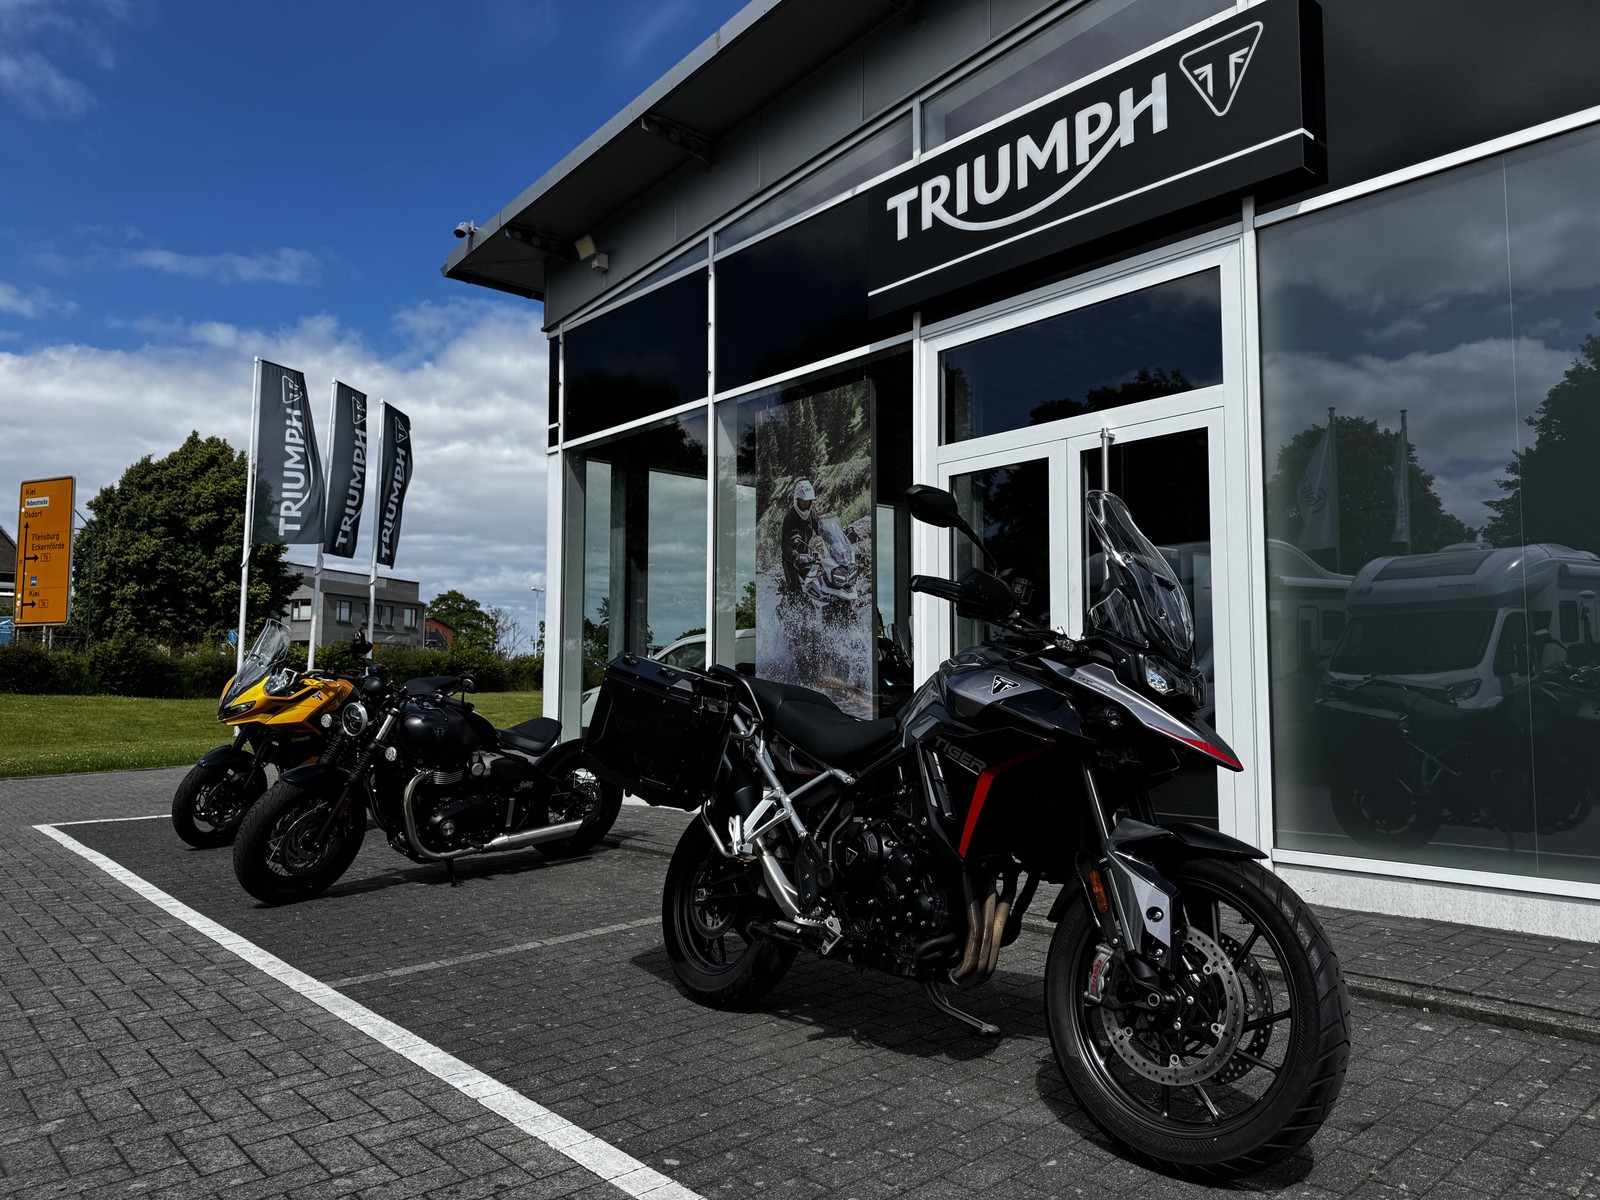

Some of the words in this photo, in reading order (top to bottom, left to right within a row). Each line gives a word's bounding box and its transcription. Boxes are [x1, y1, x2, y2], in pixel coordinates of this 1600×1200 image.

[886, 72, 1168, 241] TRIUMPH
[278, 408, 313, 536] TRIUMPH
[25, 488, 36, 496] Kiel
[335, 428, 367, 549] TRIUMPH
[24, 510, 43, 519] Osdorf
[382, 447, 406, 559] TRIUMPH
[31, 542, 65, 551] Eckernförde
[32, 533, 60, 542] Flensburg
[28, 590, 40, 598] Kiel
[934, 735, 987, 773] TIGER
